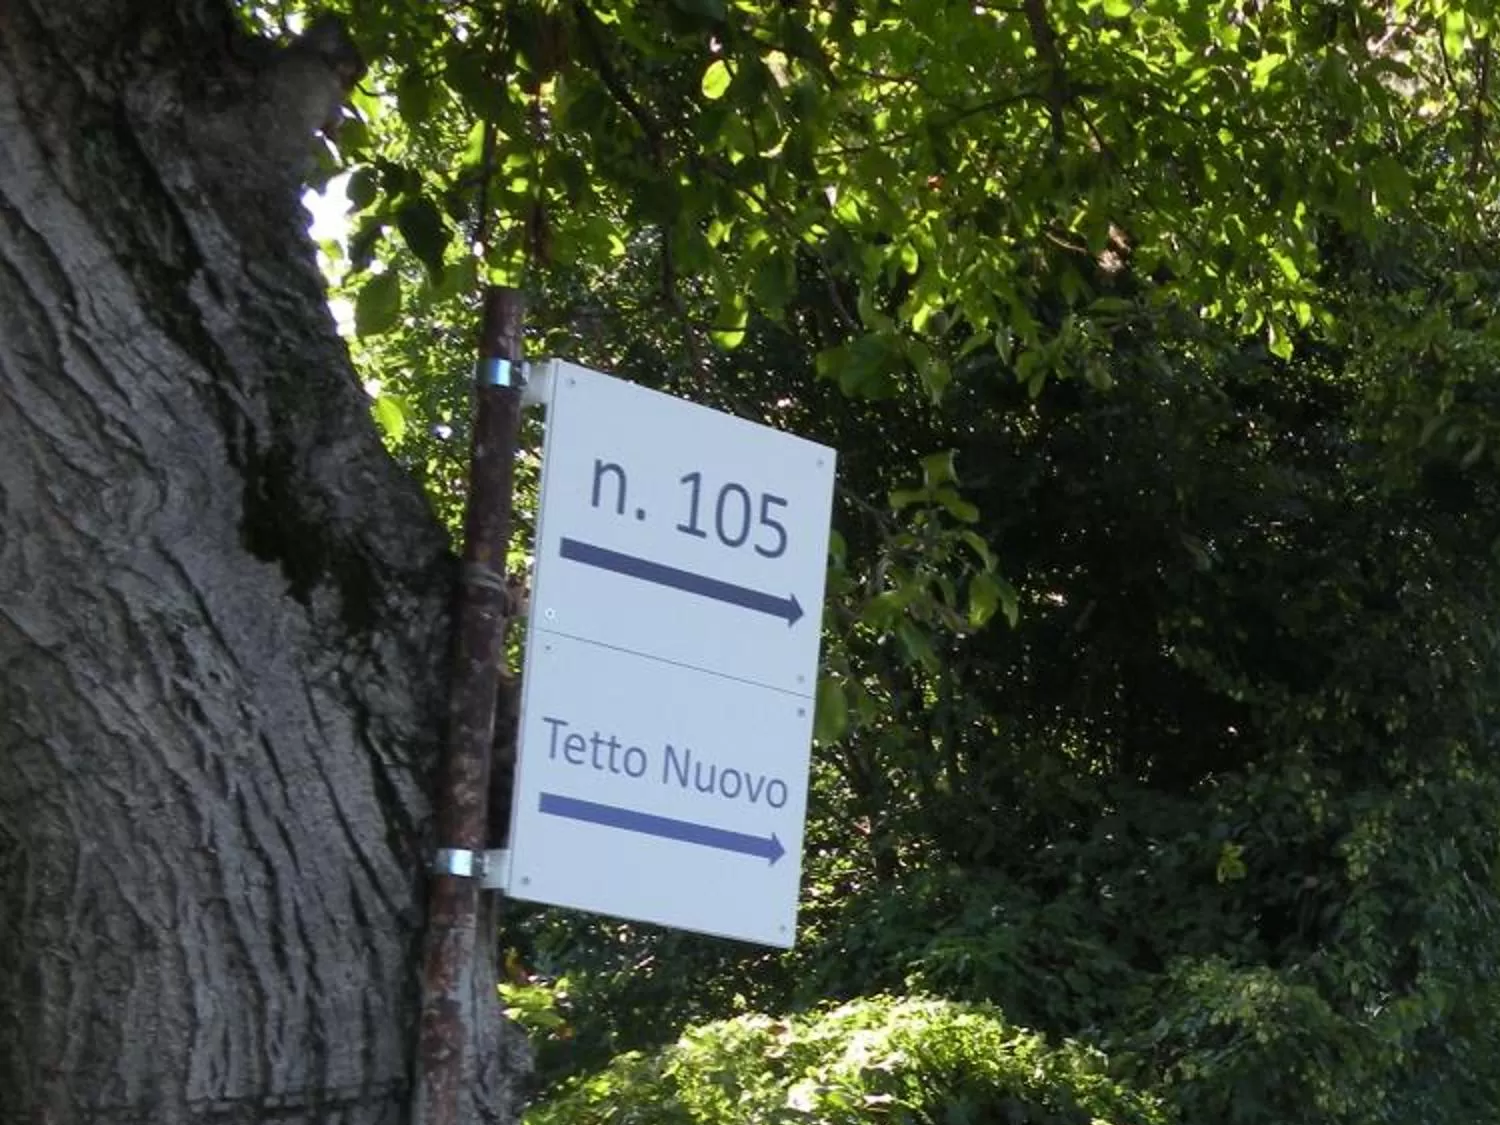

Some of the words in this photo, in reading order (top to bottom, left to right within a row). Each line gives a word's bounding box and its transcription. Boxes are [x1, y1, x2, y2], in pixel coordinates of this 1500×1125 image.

[590, 458, 646, 521] n.
[676, 470, 789, 559] 105
[542, 716, 648, 778] Tetto
[662, 744, 789, 809] Nuovo
